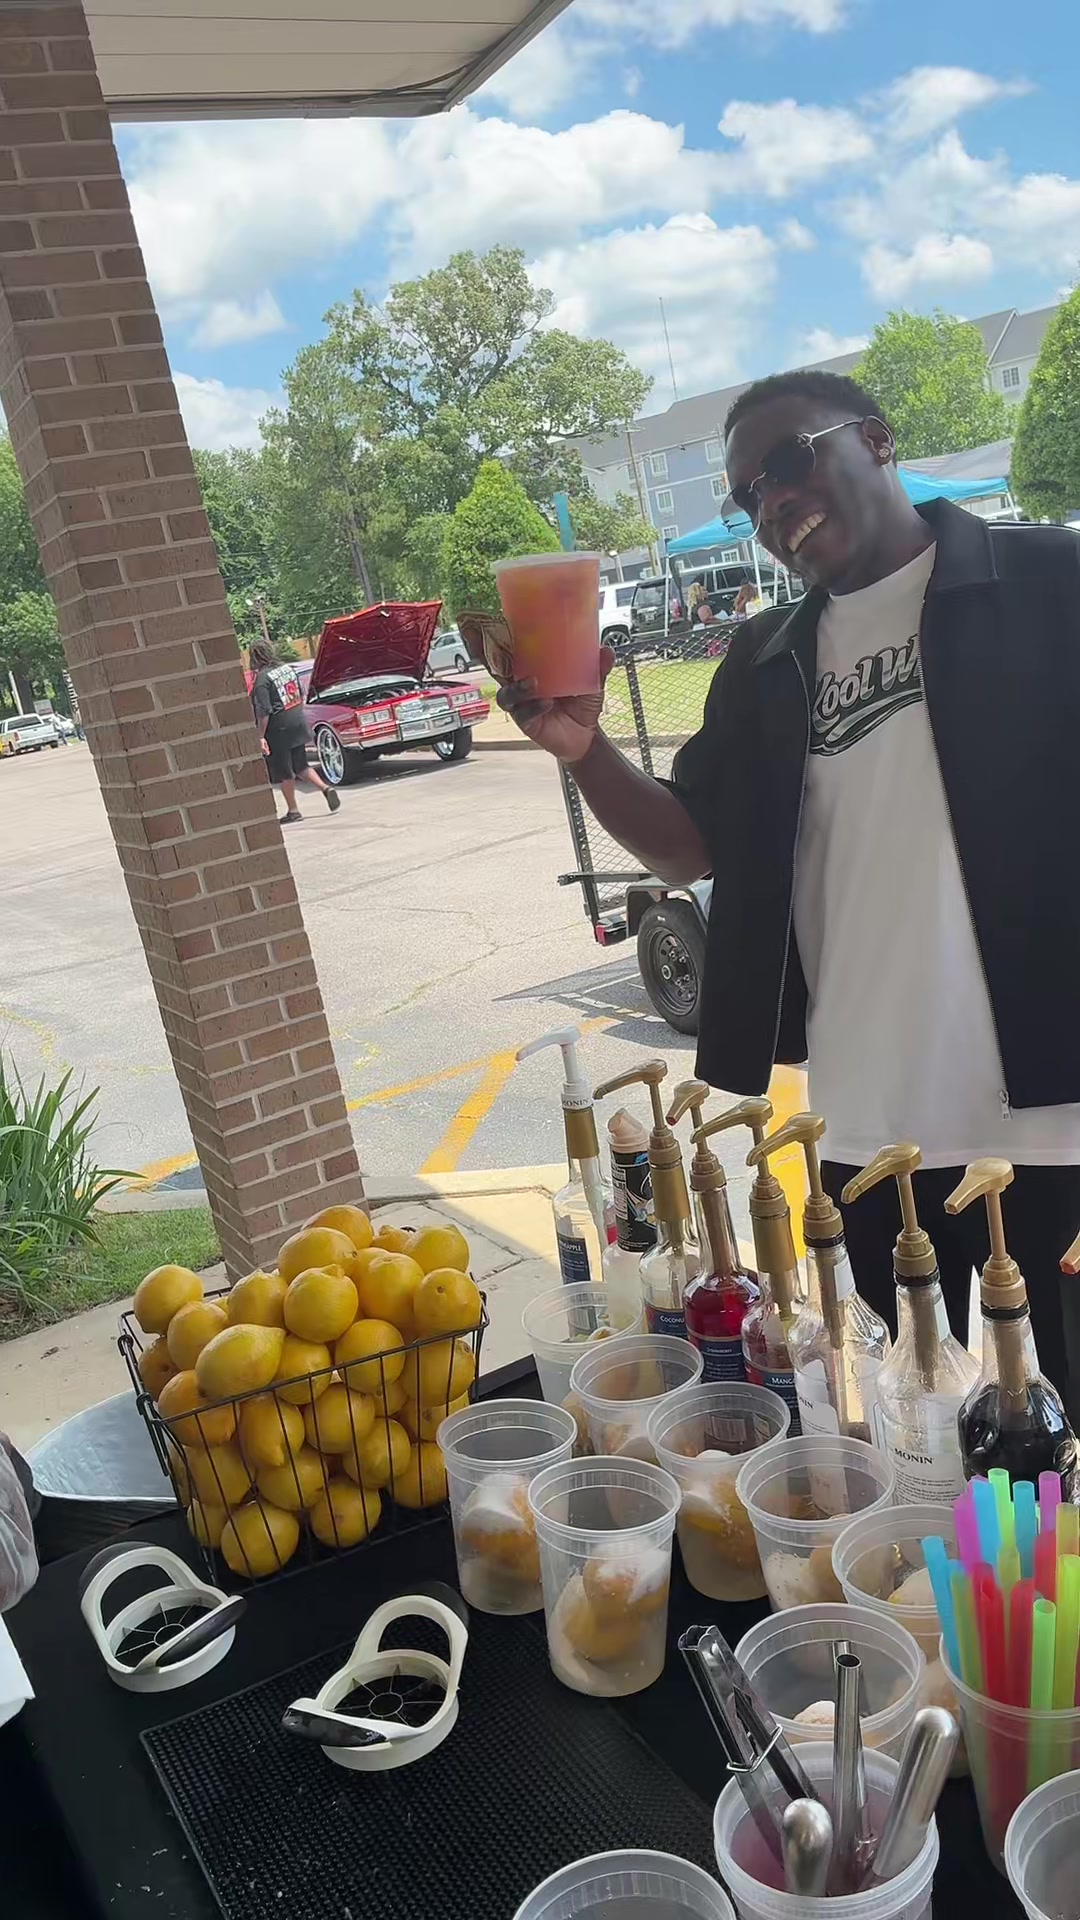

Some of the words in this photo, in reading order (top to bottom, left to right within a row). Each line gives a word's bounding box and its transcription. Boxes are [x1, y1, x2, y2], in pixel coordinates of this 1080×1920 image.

[811, 655, 875, 734] Kool
[876, 633, 923, 692] W
[659, 1314, 686, 1324] COCONU
[771, 1377, 796, 1385] MANG
[894, 1447, 933, 1465] MONIN
